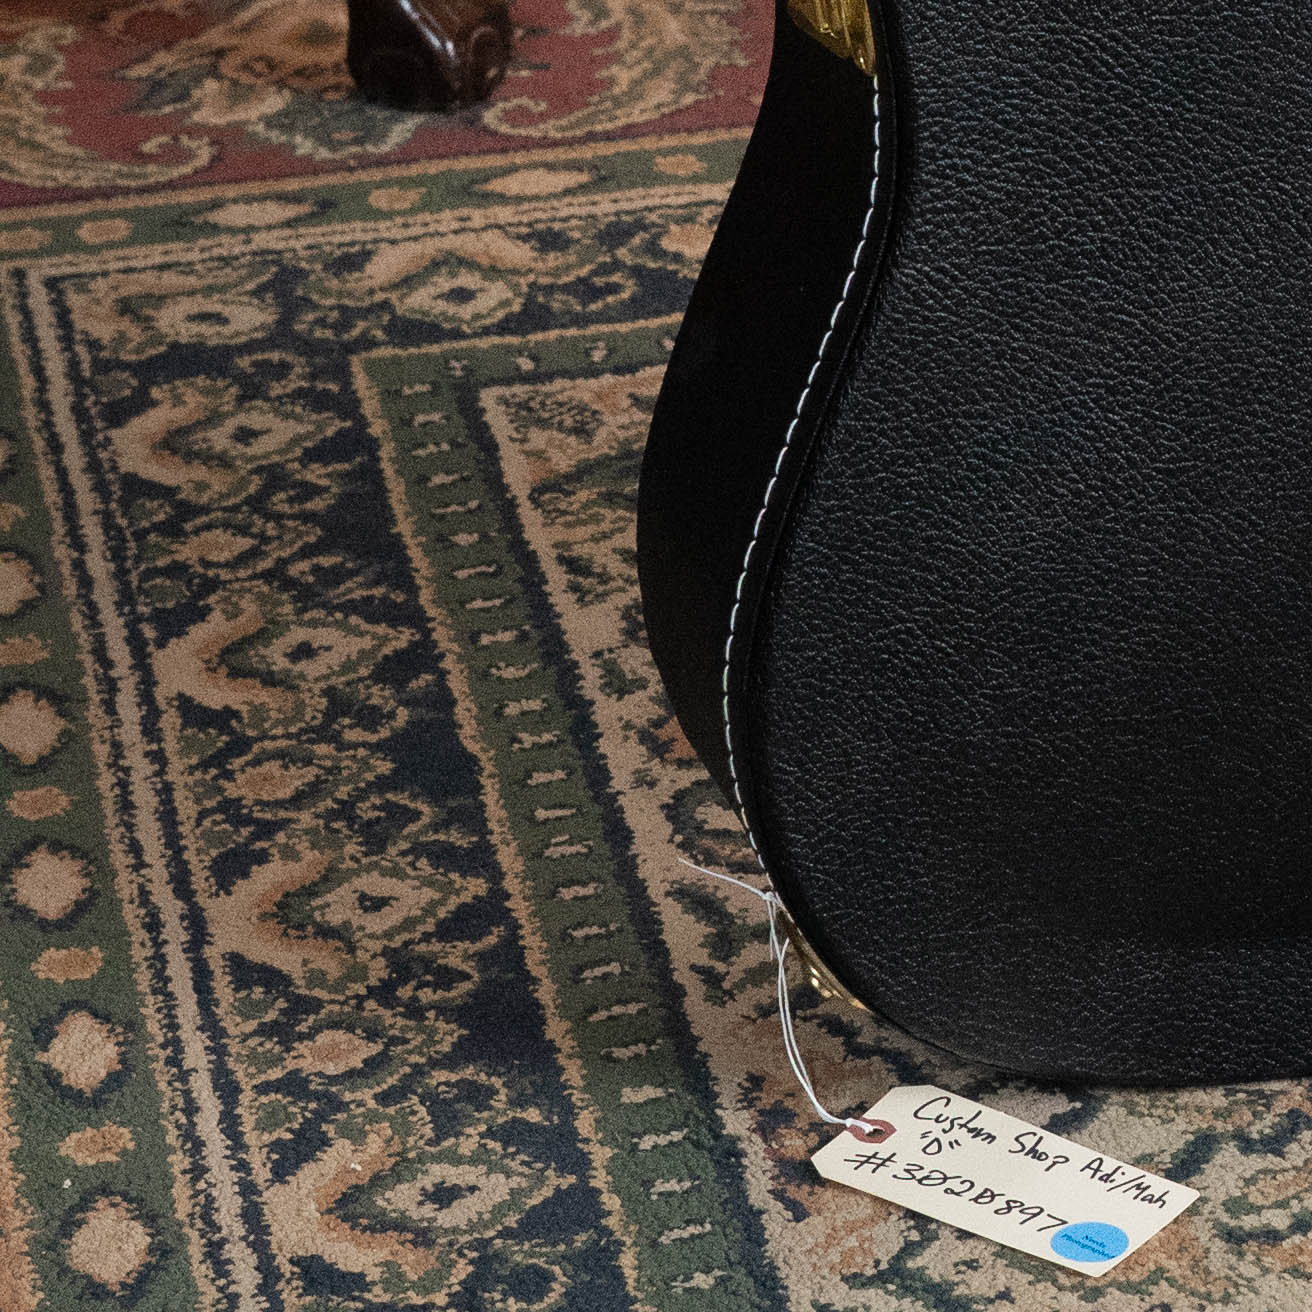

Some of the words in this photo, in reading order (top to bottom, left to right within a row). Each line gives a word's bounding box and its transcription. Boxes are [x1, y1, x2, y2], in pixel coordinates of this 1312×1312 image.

[913, 1096, 997, 1145] Custom
[1008, 1131, 1070, 1172] Shop
[1079, 1157, 1170, 1209] Adi/Mah
